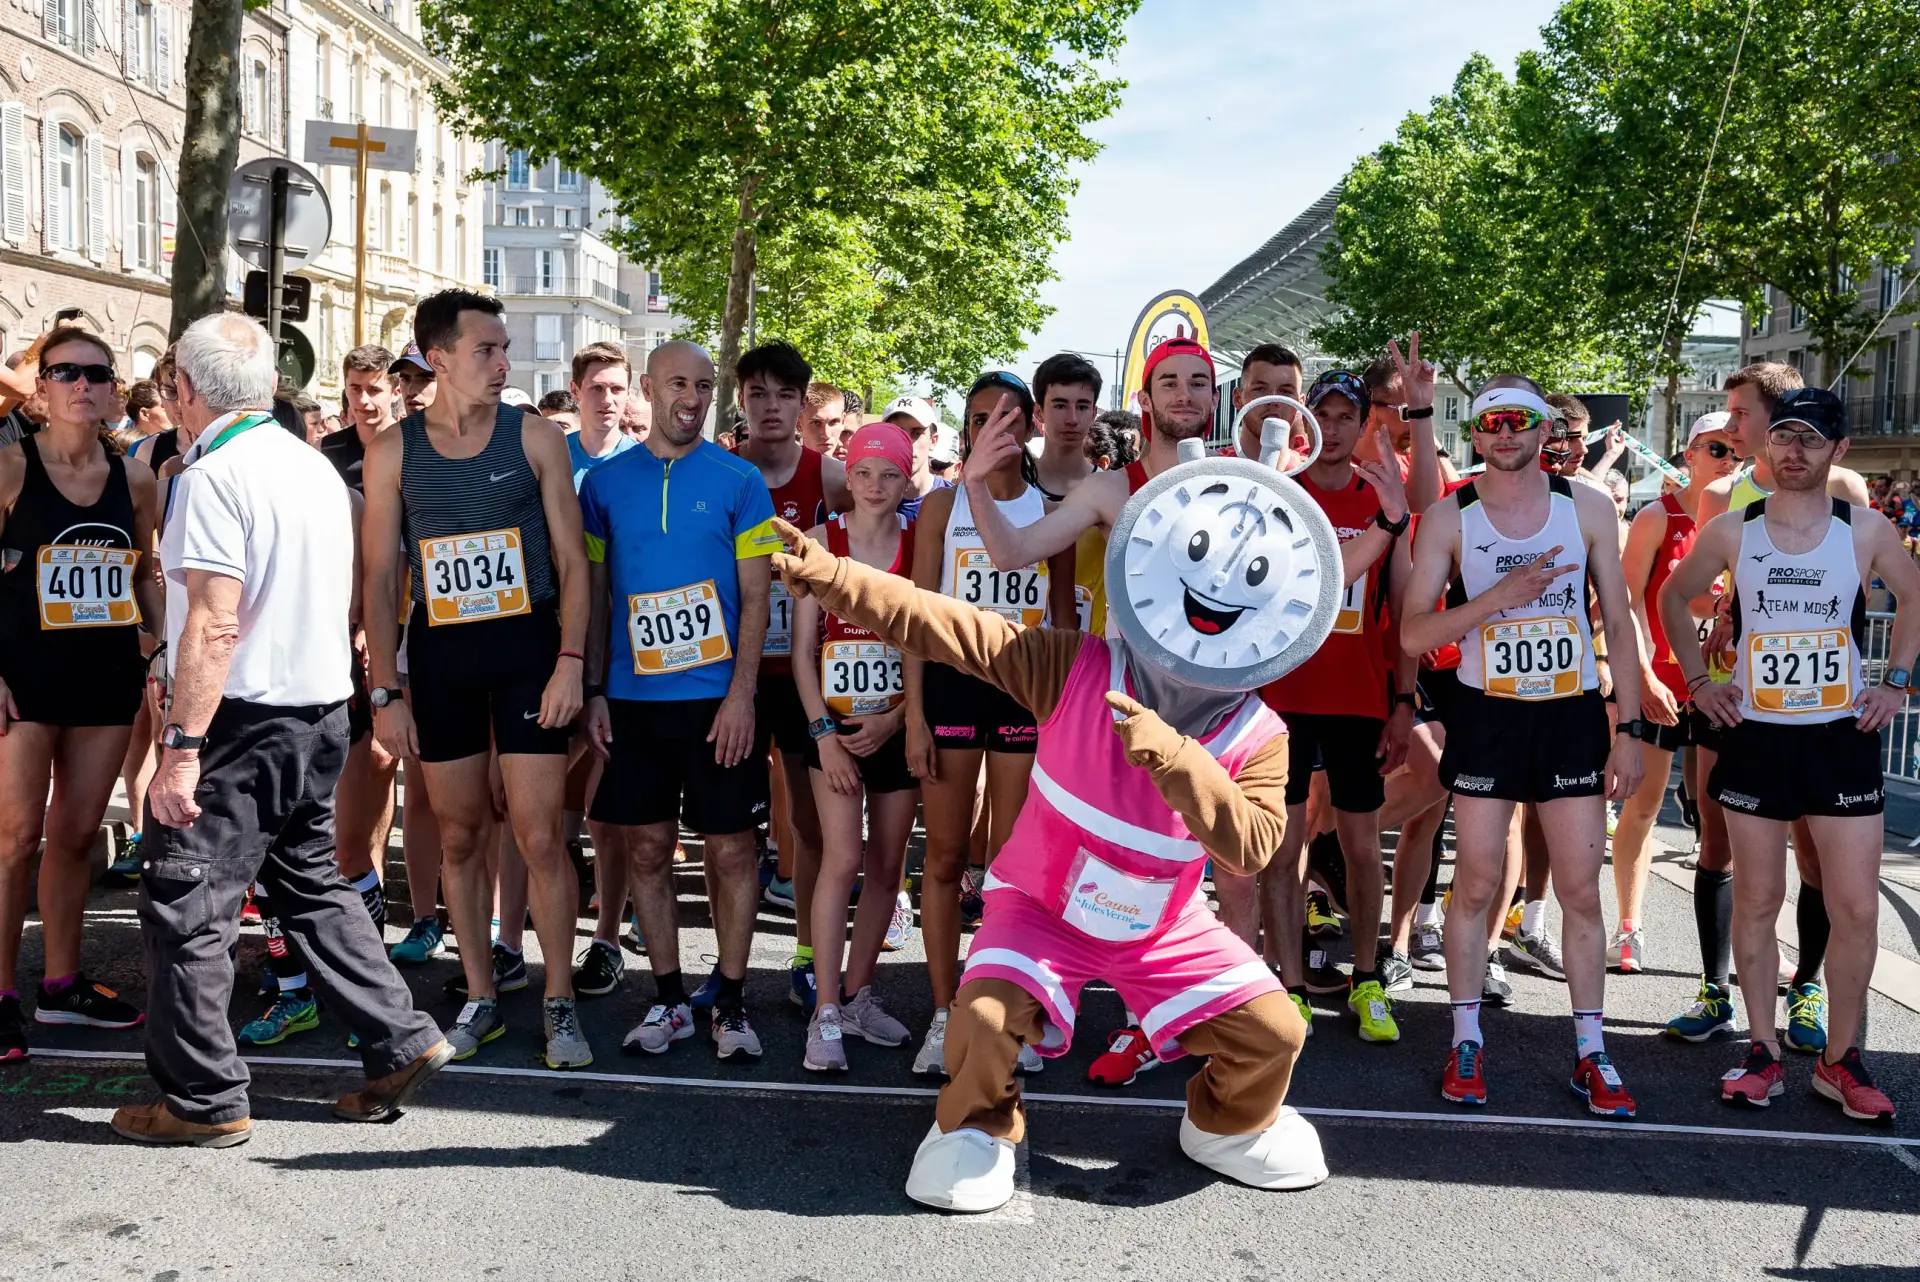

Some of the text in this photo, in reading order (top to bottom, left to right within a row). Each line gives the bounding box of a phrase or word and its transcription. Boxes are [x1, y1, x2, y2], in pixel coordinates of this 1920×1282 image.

[49, 566, 122, 599] 4010
[435, 552, 515, 594] 3034
[1767, 567, 1827, 579] PROSPORT
[966, 570, 1038, 605] 3186
[1539, 593, 1563, 608] MDS
[1767, 599, 1828, 615] TEAM MDS
[637, 604, 711, 647] 3039
[1495, 638, 1573, 674] 3030
[834, 661, 904, 693] 3033
[1762, 650, 1839, 685] 3215
[1454, 779, 1493, 792] PROSPORT
[1561, 777, 1592, 786] TEAM MDS
[1719, 794, 1758, 811] PROSPORT
[1845, 795, 1862, 804] TEAM
[1074, 895, 1081, 903] la
[1094, 892, 1142, 915] Courir
